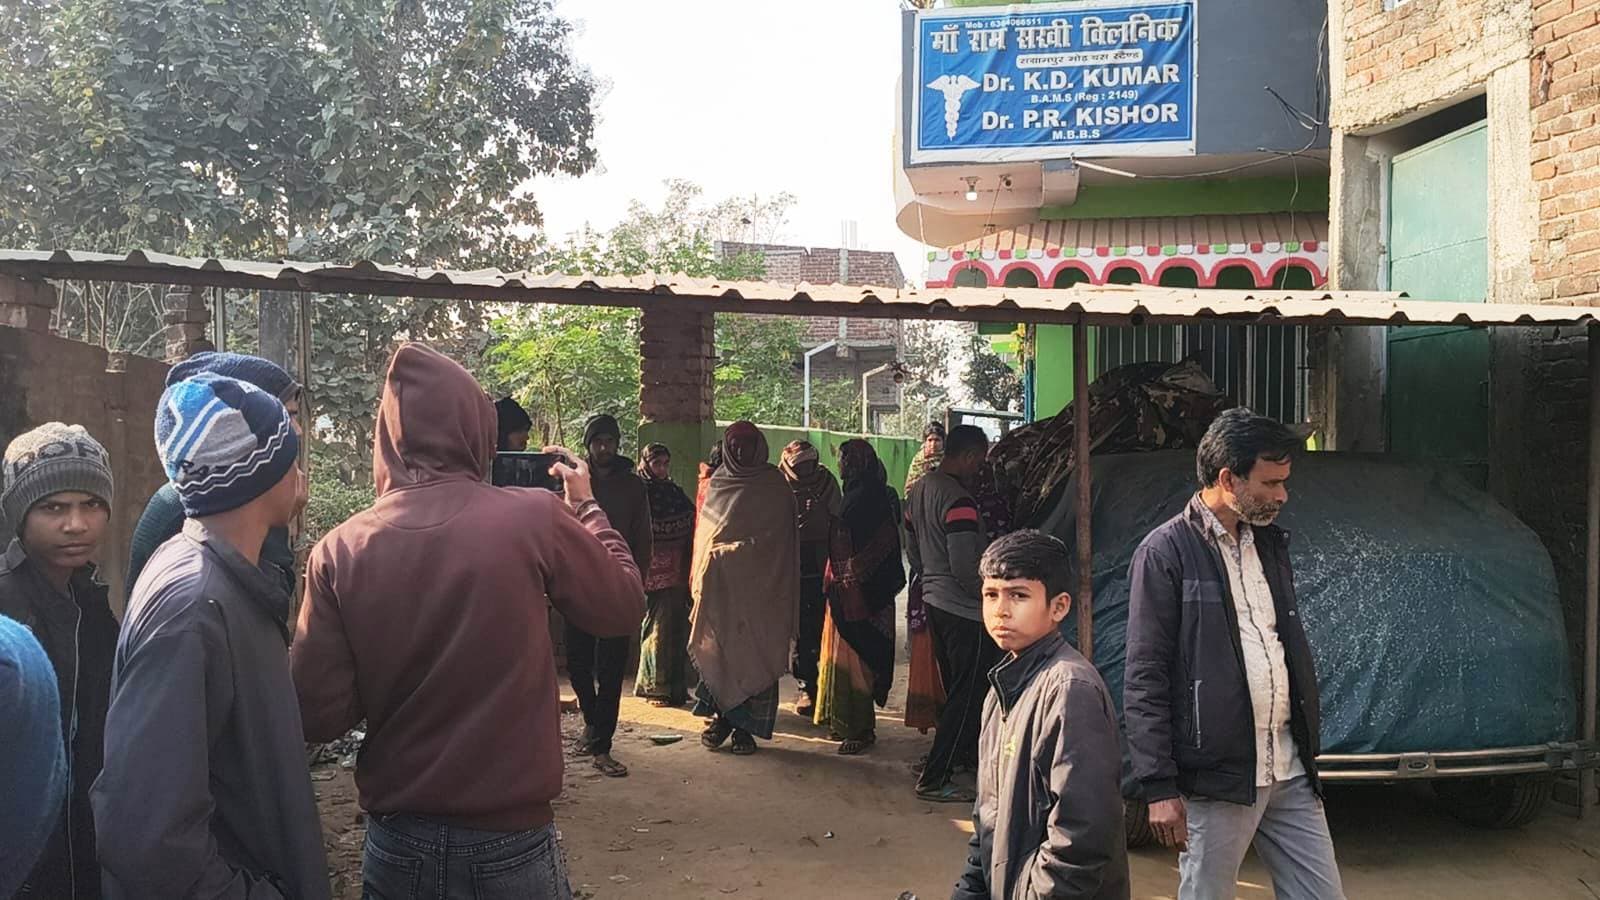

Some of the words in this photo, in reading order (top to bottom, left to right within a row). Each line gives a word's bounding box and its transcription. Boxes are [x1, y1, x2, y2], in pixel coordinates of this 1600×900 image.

[968, 26, 1008, 53] राम
[1015, 18, 1073, 50] सखी
[1080, 13, 1184, 47] क्लिनिक
[983, 73, 1015, 92] Dr.
[1023, 70, 1073, 91] K.D.
[1083, 64, 1180, 88] KUMAR
[1031, 92, 1072, 104] B.A.M.S
[1075, 91, 1099, 104] (Reg
[1108, 89, 1139, 102] 2149)
[983, 111, 1014, 130] Dr.
[1023, 108, 1066, 129] P.R.
[1076, 103, 1179, 126] KISHOR
[1052, 129, 1101, 141] M.B.B.S
